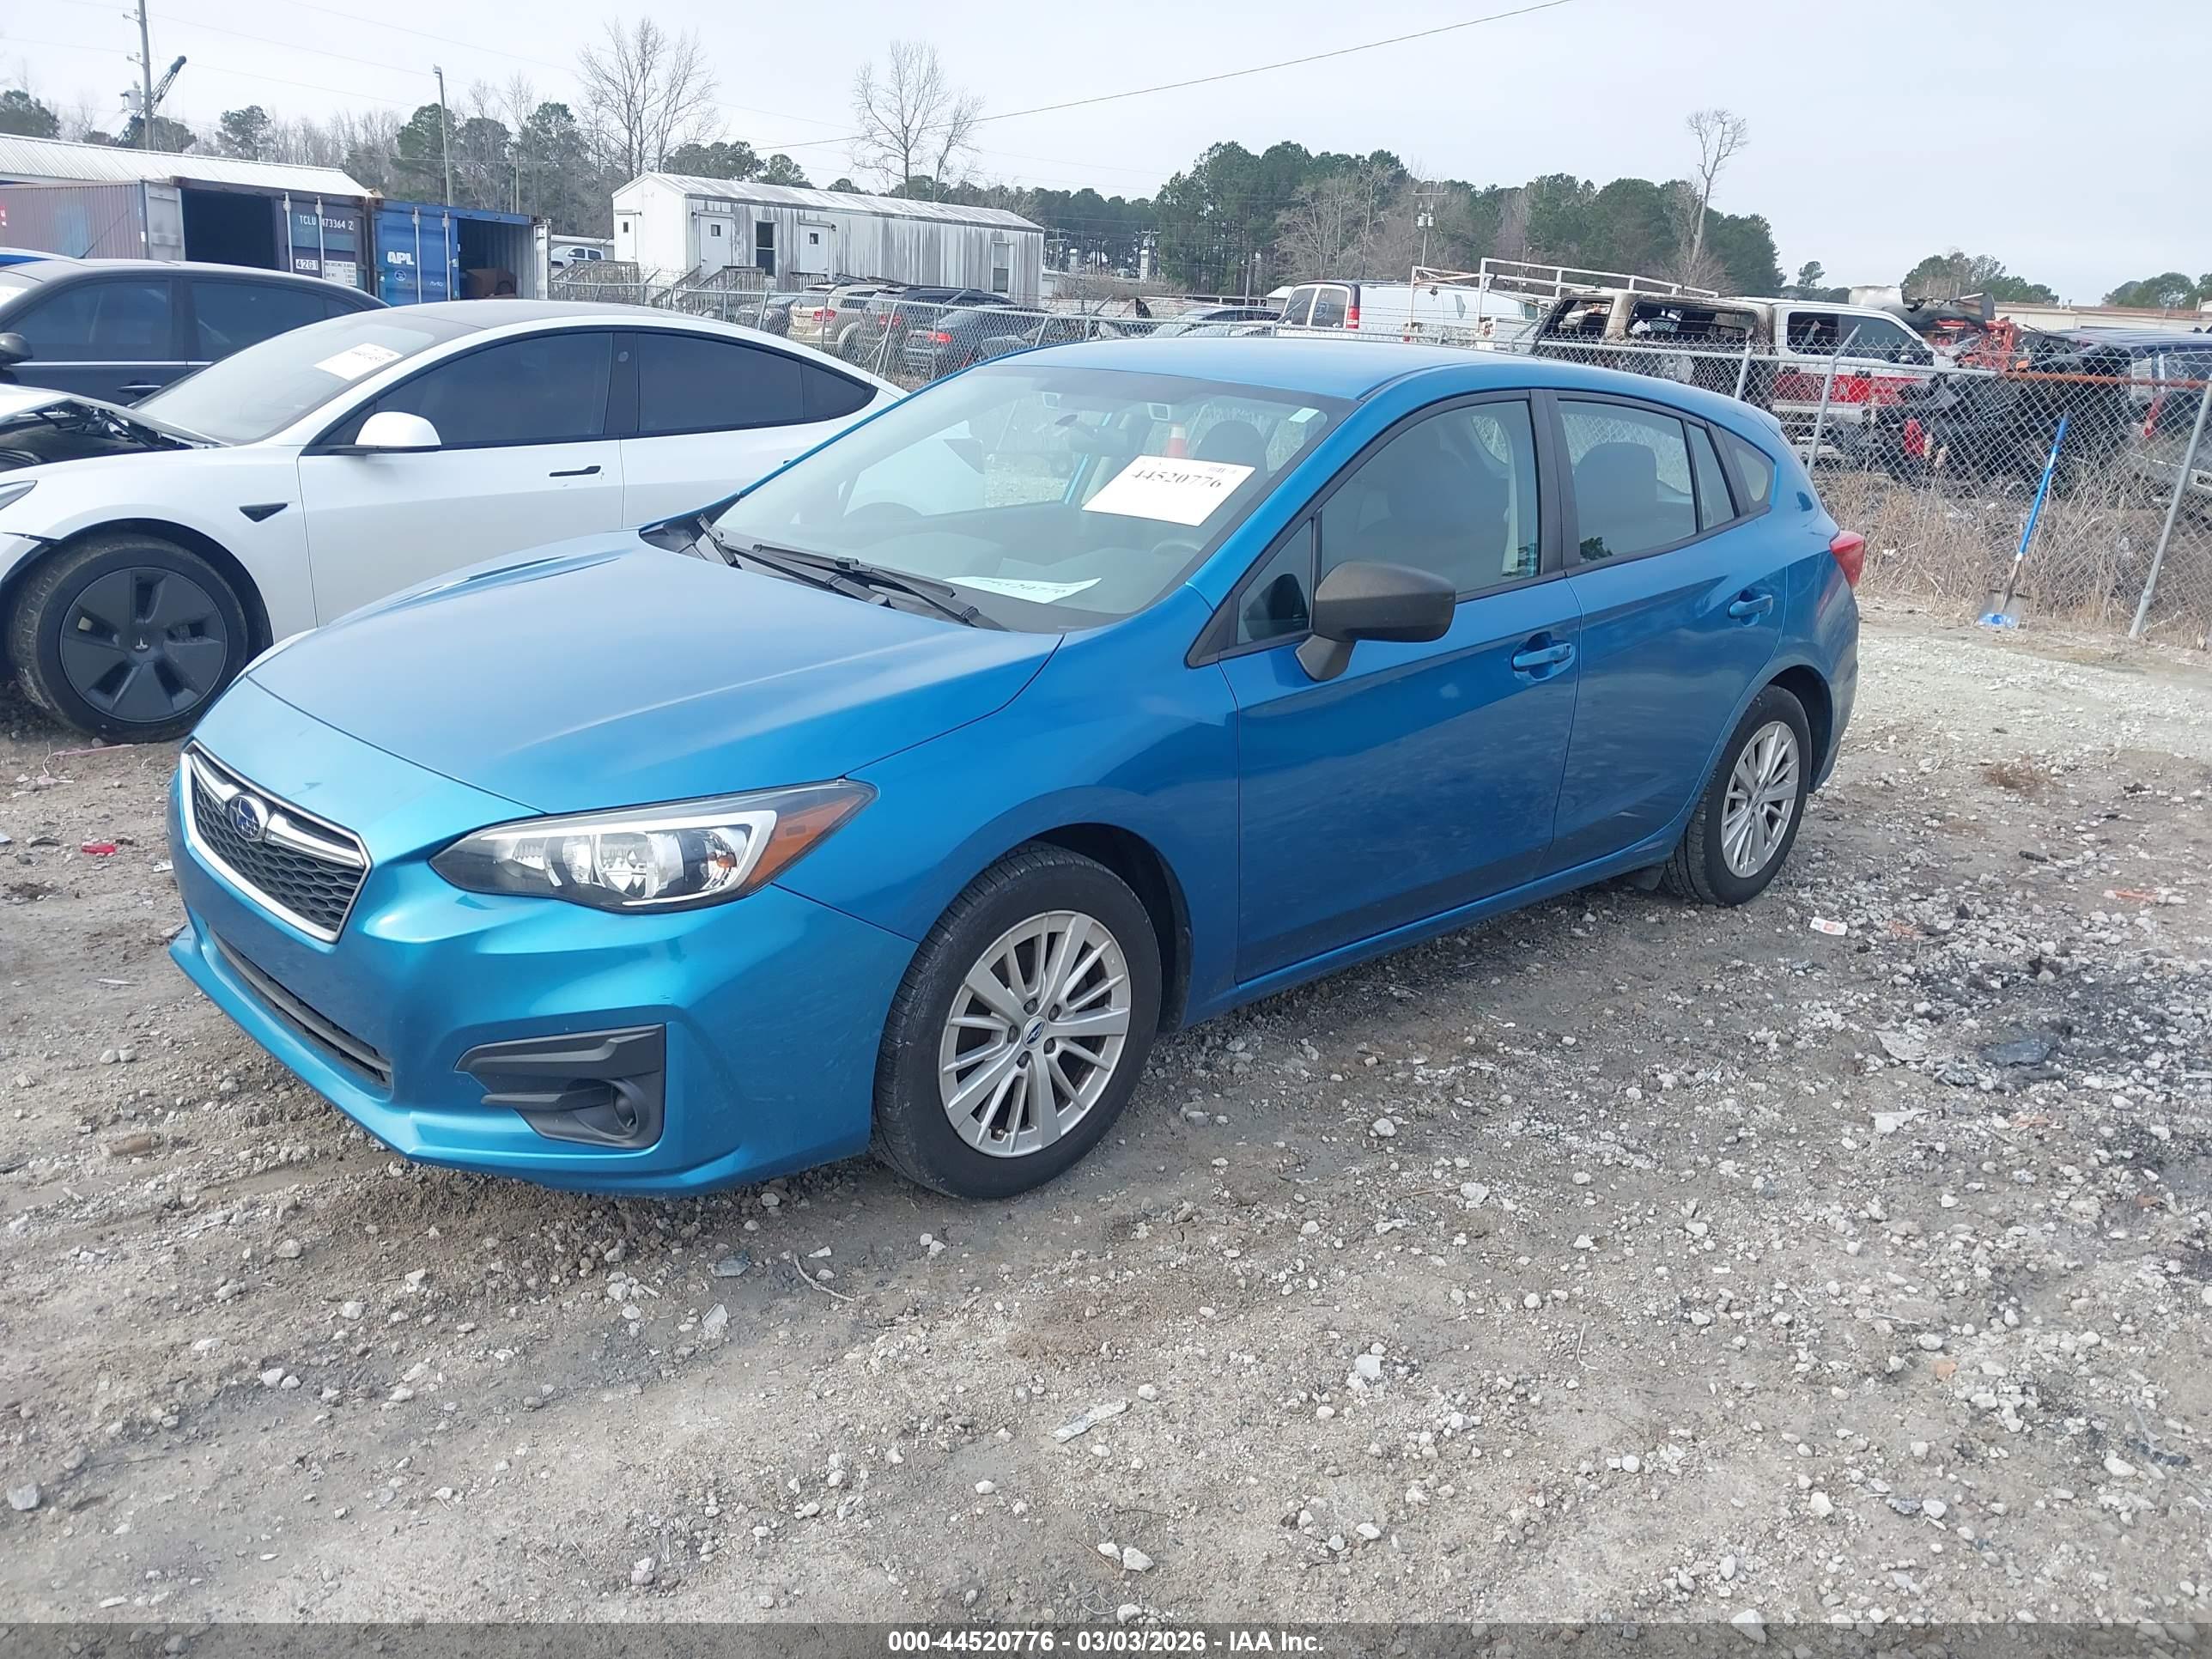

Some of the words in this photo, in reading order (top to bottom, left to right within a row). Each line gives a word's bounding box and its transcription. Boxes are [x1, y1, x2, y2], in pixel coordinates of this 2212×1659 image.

[299, 215, 316, 226] TCLU
[348, 221, 354, 231] 2
[387, 251, 415, 265] APL
[1132, 469, 1222, 488] 44520776
